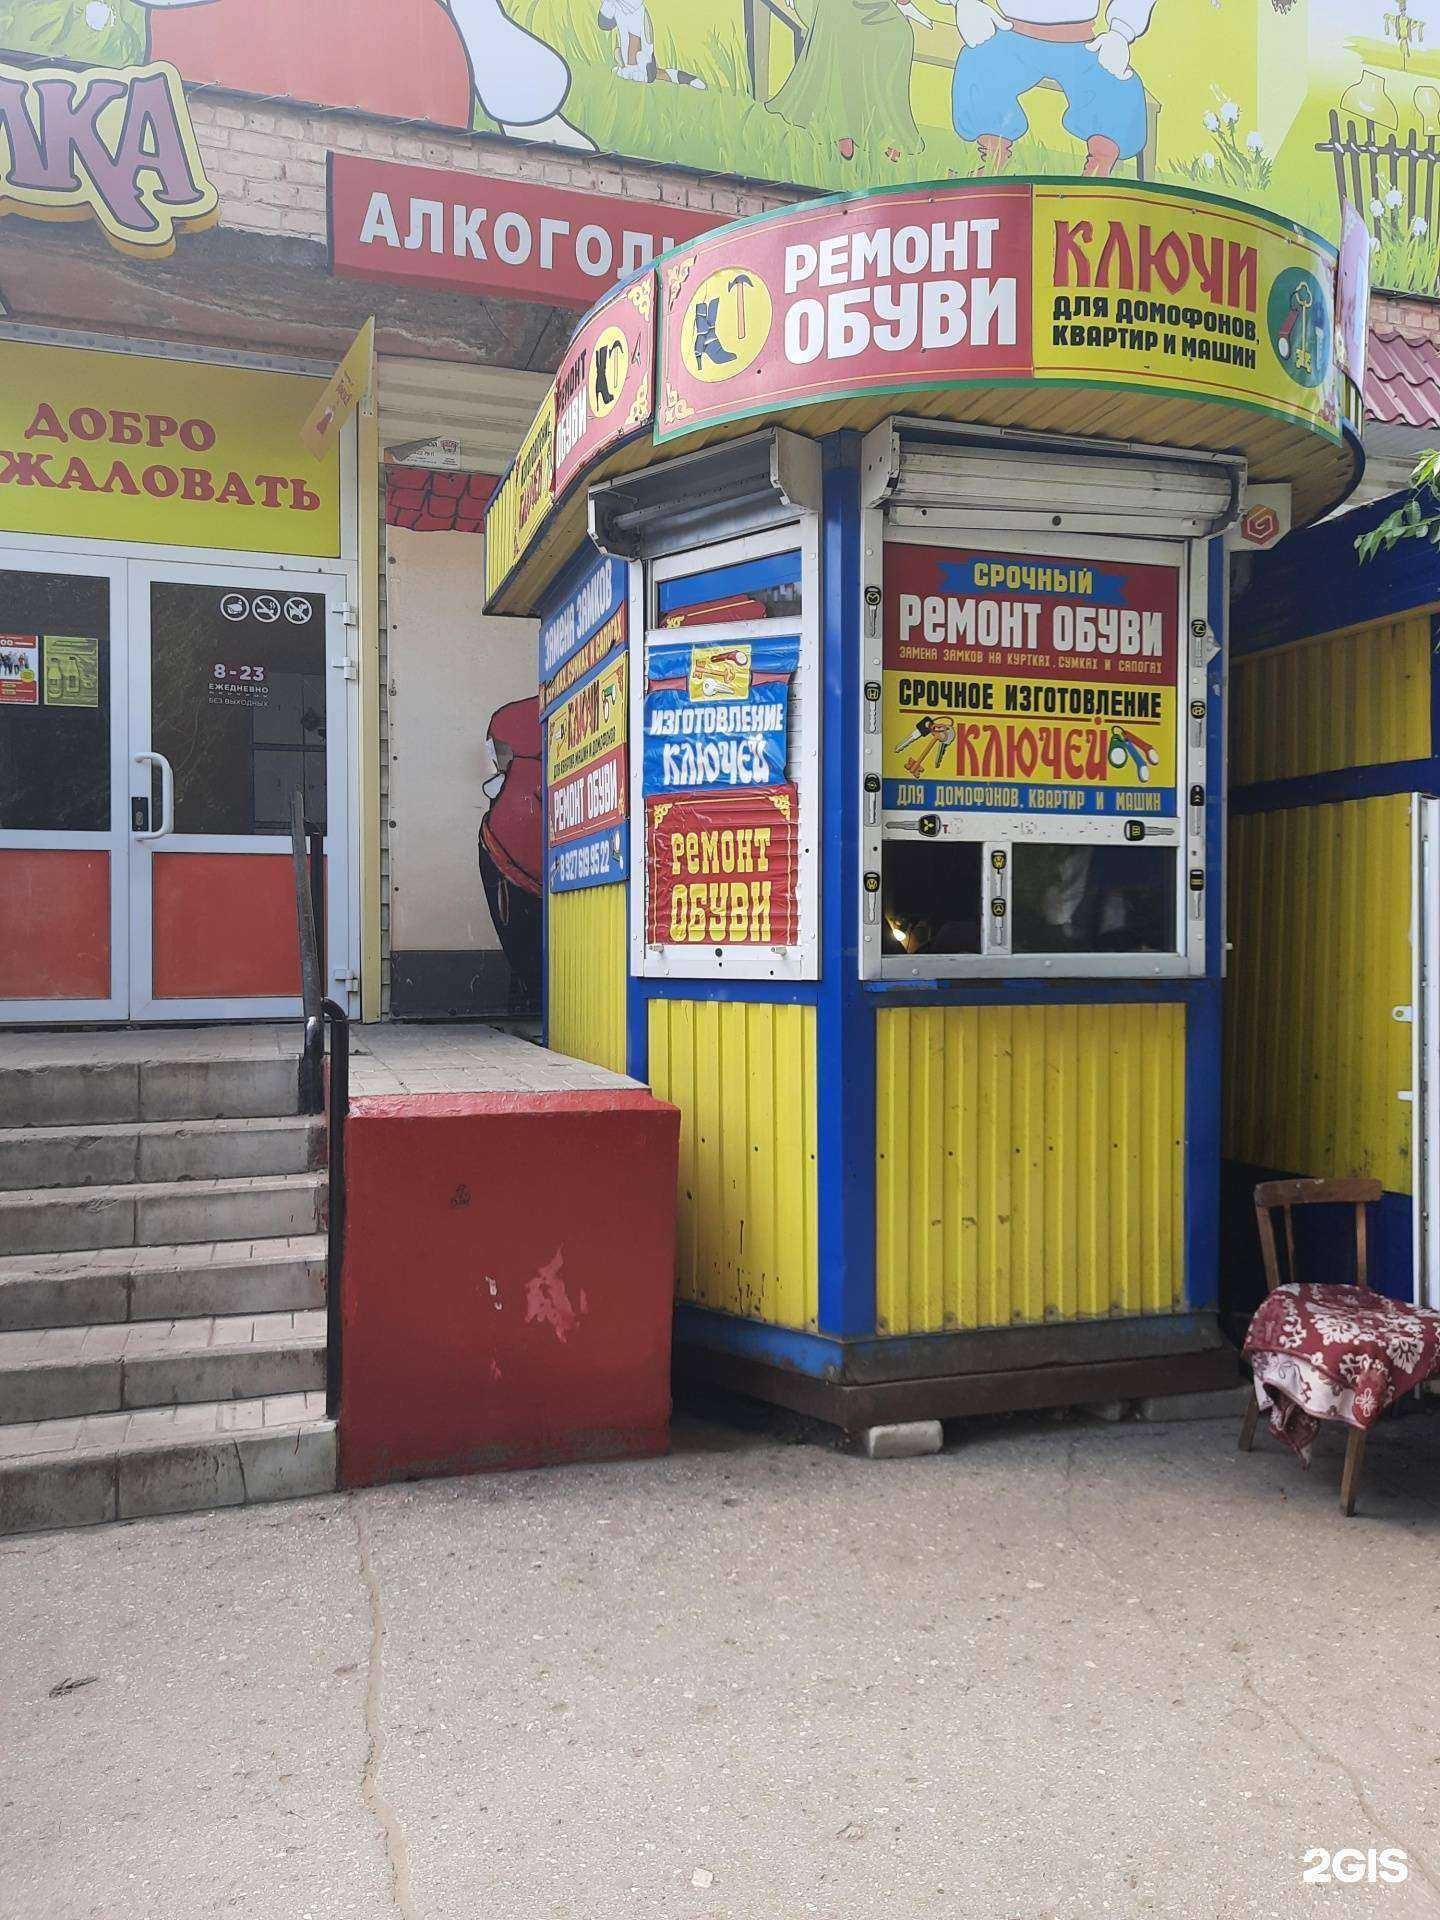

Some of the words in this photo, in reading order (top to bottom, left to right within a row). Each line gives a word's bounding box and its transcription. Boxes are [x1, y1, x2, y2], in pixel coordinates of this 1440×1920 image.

[785, 219, 1000, 294] РЕМОНТ
[1053, 220, 1258, 313] КЛЮЧИ
[785, 277, 1017, 365] ОБУВИ
[1053, 296, 1108, 320] ДЛЯ
[1116, 299, 1259, 345] ДОМОФОНОВ,
[1053, 325, 1158, 351] КВАРТИР
[1164, 333, 1175, 354] И
[1182, 337, 1256, 369] МАШИН
[24, 403, 216, 451] ДОБРО
[0, 451, 321, 511] ЖАЛОВАТЬ
[577, 558, 612, 639] ЗАМКОВ
[974, 562, 1094, 594] СРОЧНЫЙ
[900, 594, 1041, 649] РЕМОНТ
[1053, 605, 1163, 656] ОБУВИ
[899, 646, 938, 661] ЗАМЕНА
[943, 650, 983, 663] ЗАМКОВ
[989, 653, 1001, 664] НА
[1059, 656, 1098, 670] СУМКАХ
[1105, 659, 1111, 671] И
[1119, 660, 1162, 674] САПОГАХ
[209, 683, 269, 693] ЕЖЕДНЕВНО
[899, 679, 993, 710] СРОЧНОЕ
[1005, 684, 1161, 718] ИЗГОТОВЛЕНИЕ
[650, 704, 783, 735] ИЗГОТОВЛЕНИЕ
[663, 733, 770, 785] КЛЮЧЕЙ
[956, 716, 1108, 781] КЛЮЧЕЙ
[554, 777, 584, 832] РЕМОНТ
[588, 759, 618, 819] ОБУВИ
[897, 784, 924, 806] ДЛЯ
[1029, 789, 1084, 810] КВАРТИР
[1096, 791, 1103, 810] И
[1116, 792, 1161, 811] МАШИН
[600, 840, 609, 873] 22
[671, 828, 770, 875] РЕМОНТ
[669, 881, 771, 942] ОБУВИ
